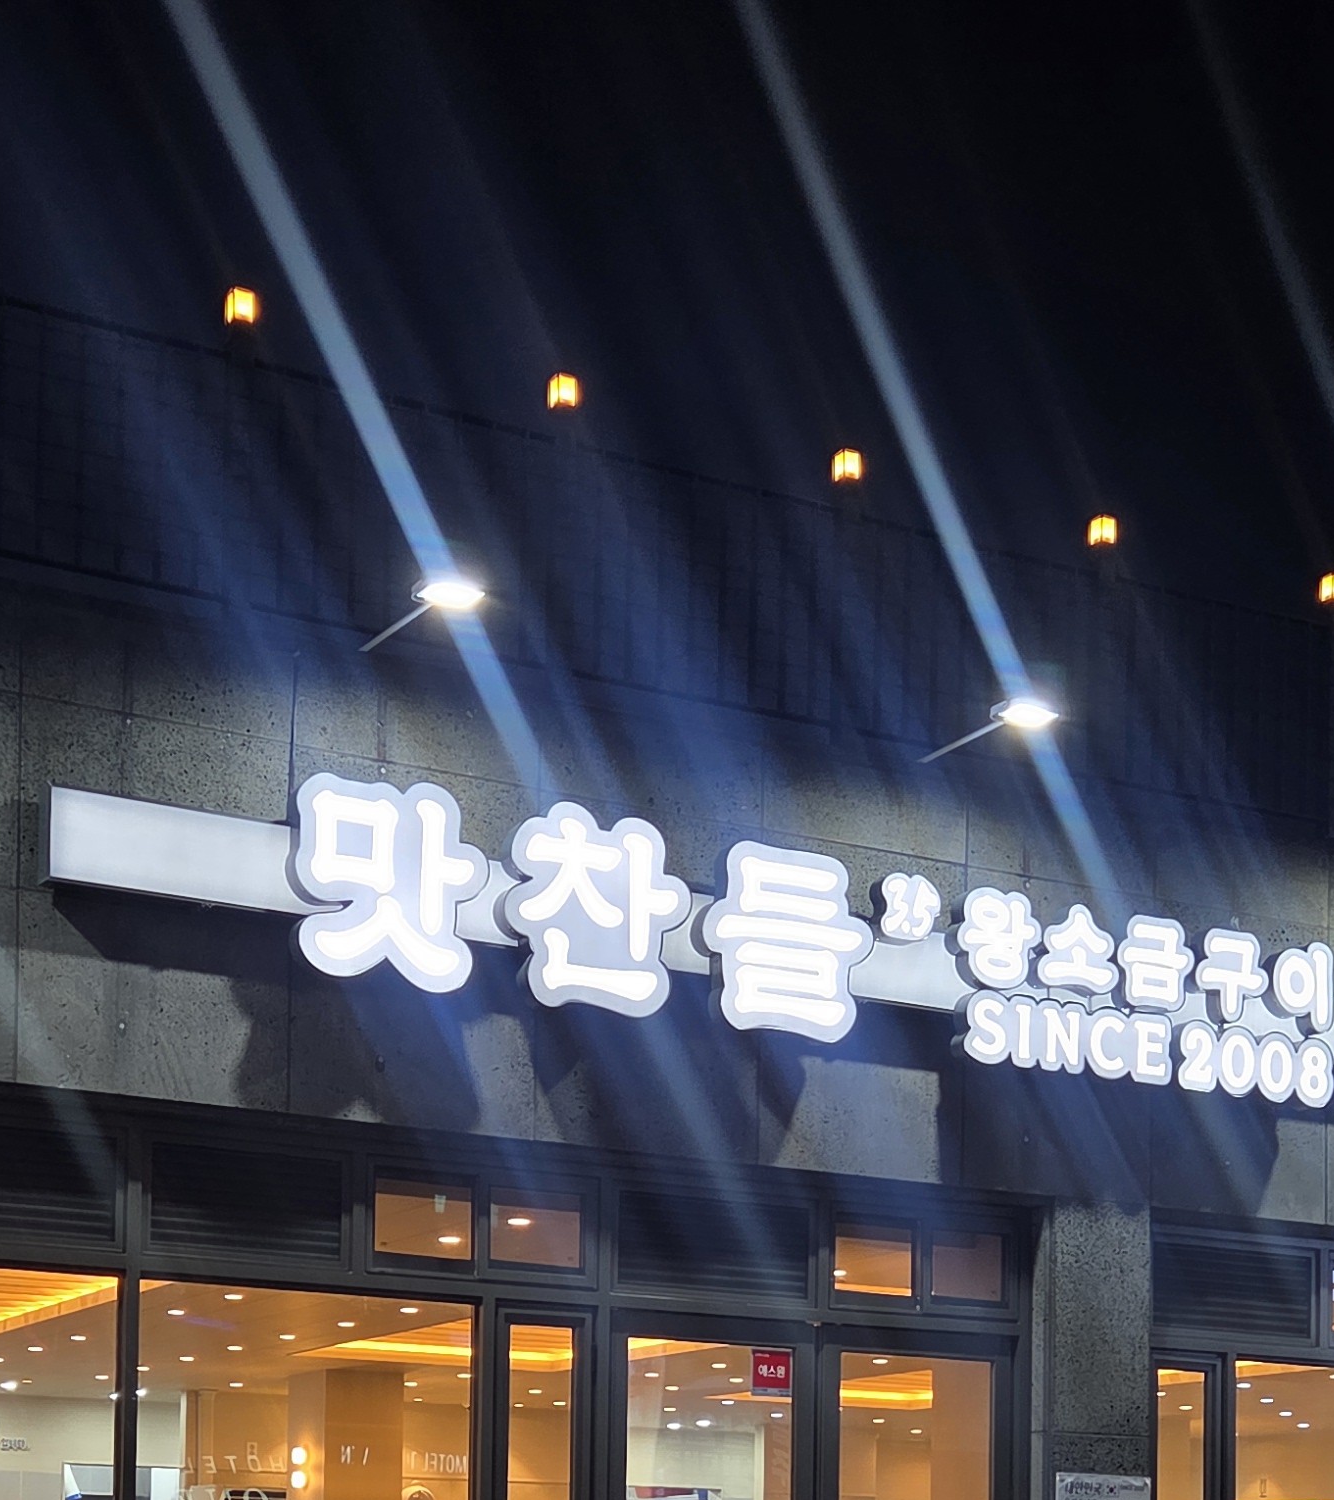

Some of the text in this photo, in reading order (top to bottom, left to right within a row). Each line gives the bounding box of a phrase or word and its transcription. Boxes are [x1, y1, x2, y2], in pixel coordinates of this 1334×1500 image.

[302, 782, 870, 1035] 맛찬들
[959, 890, 1332, 1032] 왕소금구이
[965, 990, 1332, 1106] SINCE 2008
